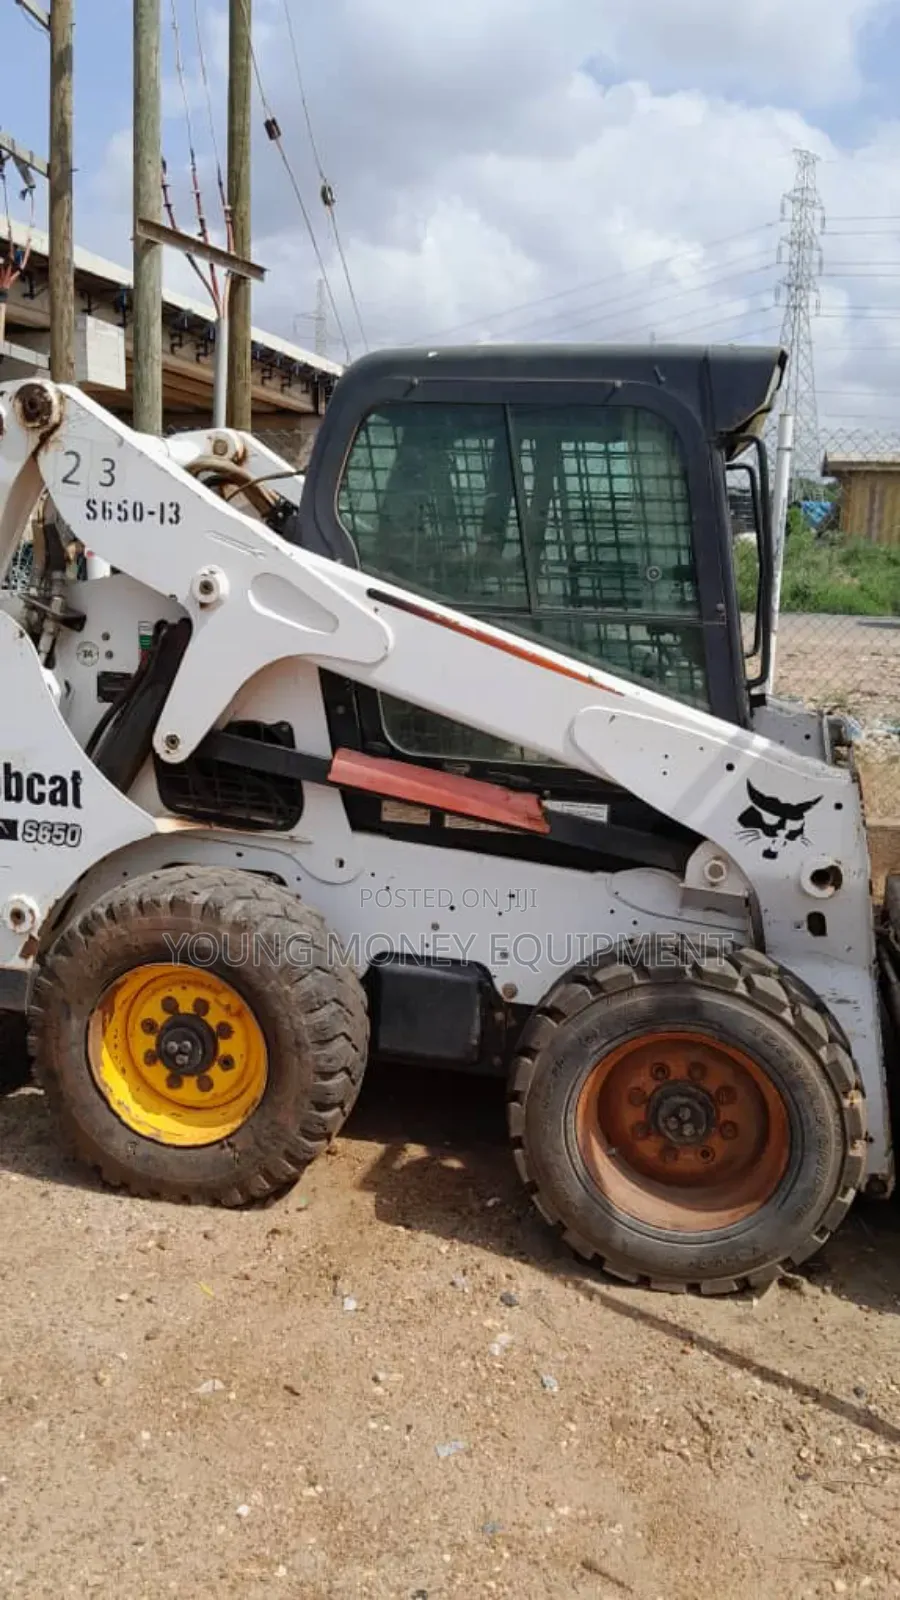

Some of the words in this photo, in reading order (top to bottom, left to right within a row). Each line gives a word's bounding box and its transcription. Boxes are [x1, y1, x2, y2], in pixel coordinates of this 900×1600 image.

[86, 497, 181, 526] S650-13
[0, 762, 82, 809] bcat
[22, 820, 82, 848] S650
